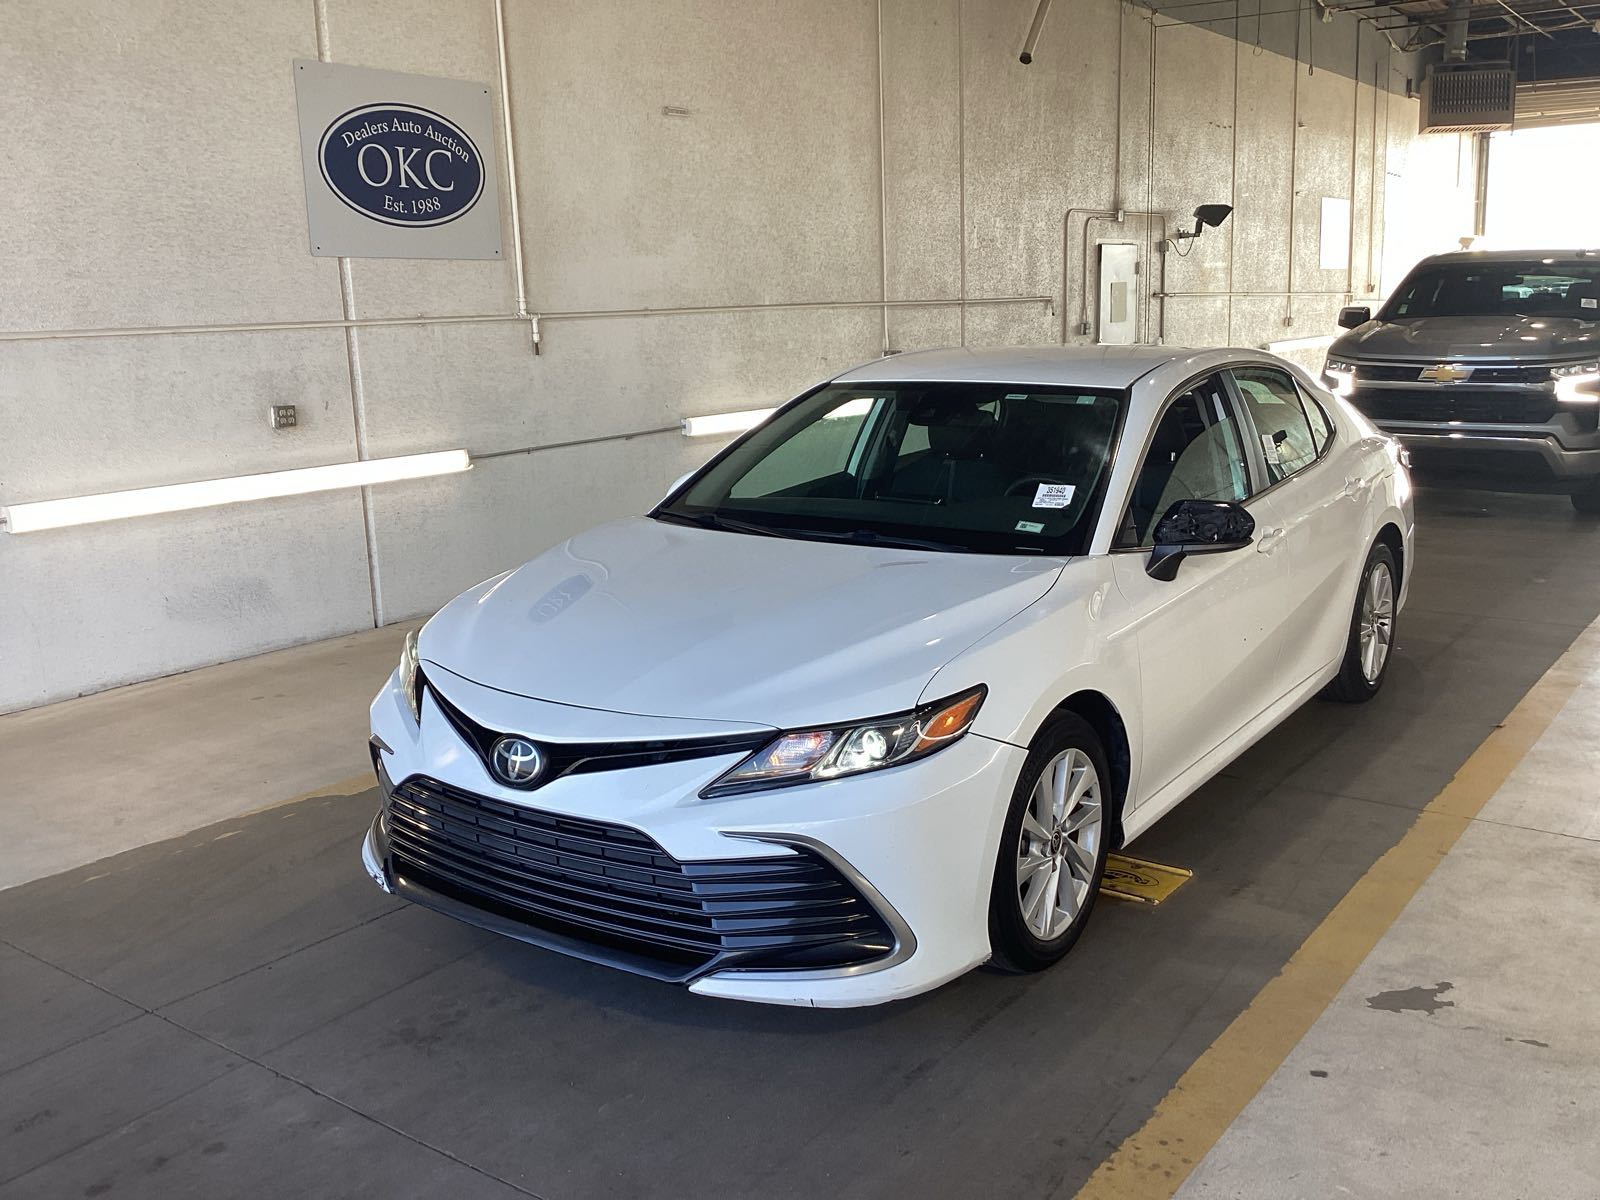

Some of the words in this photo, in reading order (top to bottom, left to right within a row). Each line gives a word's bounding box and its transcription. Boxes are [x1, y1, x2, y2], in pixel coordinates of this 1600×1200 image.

[341, 121, 389, 148] Dealers
[391, 117, 422, 135] Auto
[424, 124, 470, 164] Auction
[357, 143, 454, 192] OKC
[383, 194, 408, 213] Est.
[412, 196, 441, 215] 1988
